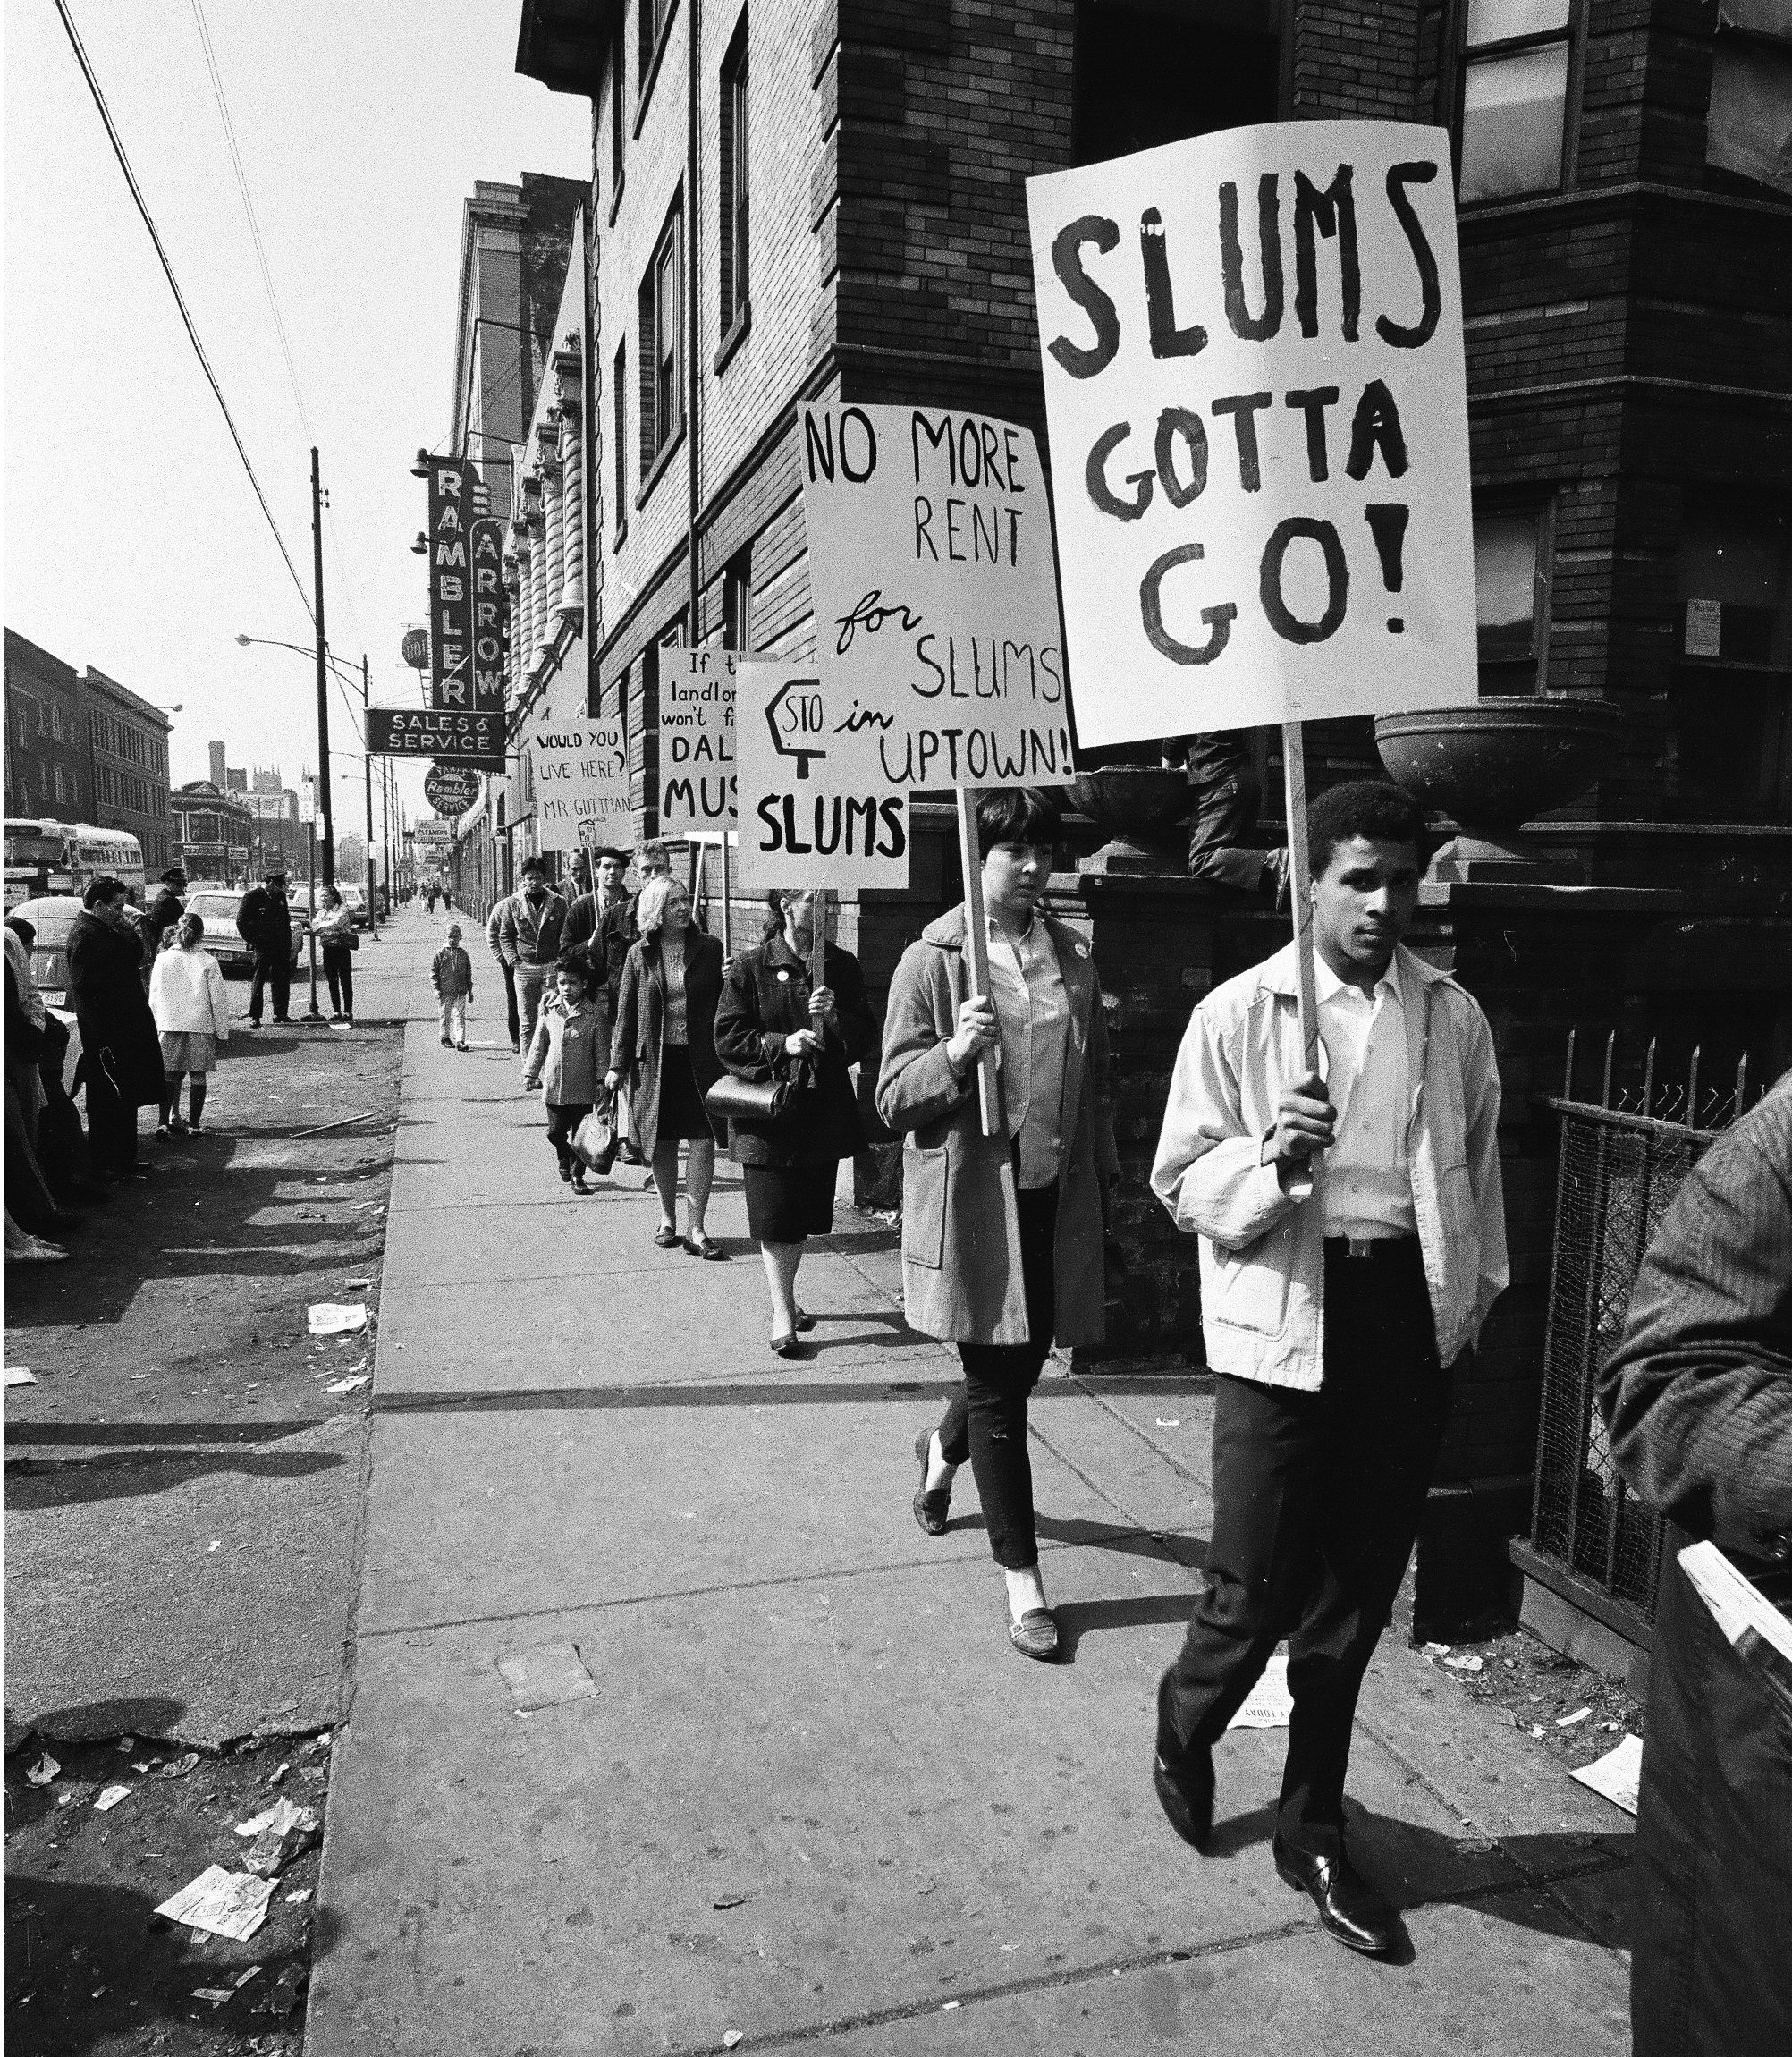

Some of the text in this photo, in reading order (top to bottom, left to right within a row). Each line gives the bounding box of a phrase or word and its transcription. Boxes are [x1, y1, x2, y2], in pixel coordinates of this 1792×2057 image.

[1047, 160, 1441, 379] SLUMS
[805, 407, 1026, 493] NO MORE
[1086, 379, 1410, 521] GOTTA
[914, 496, 1022, 567] RENT
[436, 470, 466, 704] RAMBLER
[1139, 502, 1410, 665] GO!
[475, 534, 503, 696] ARROW
[835, 590, 923, 655] for
[689, 653, 710, 673] If
[911, 633, 1061, 704] SLUMS
[388, 732, 490, 750] SERVICE
[393, 715, 490, 732] SALES &
[537, 732, 619, 749] WOULD YOU
[661, 706, 706, 726] won't
[833, 699, 893, 733] in
[540, 750, 626, 781] LIVE HERE?
[880, 727, 1073, 784] UPTOWN!
[427, 780, 478, 796] Rambler
[432, 797, 470, 812] SERVICE
[573, 795, 632, 816] GUTTMAN
[757, 793, 906, 859] SLUMS
